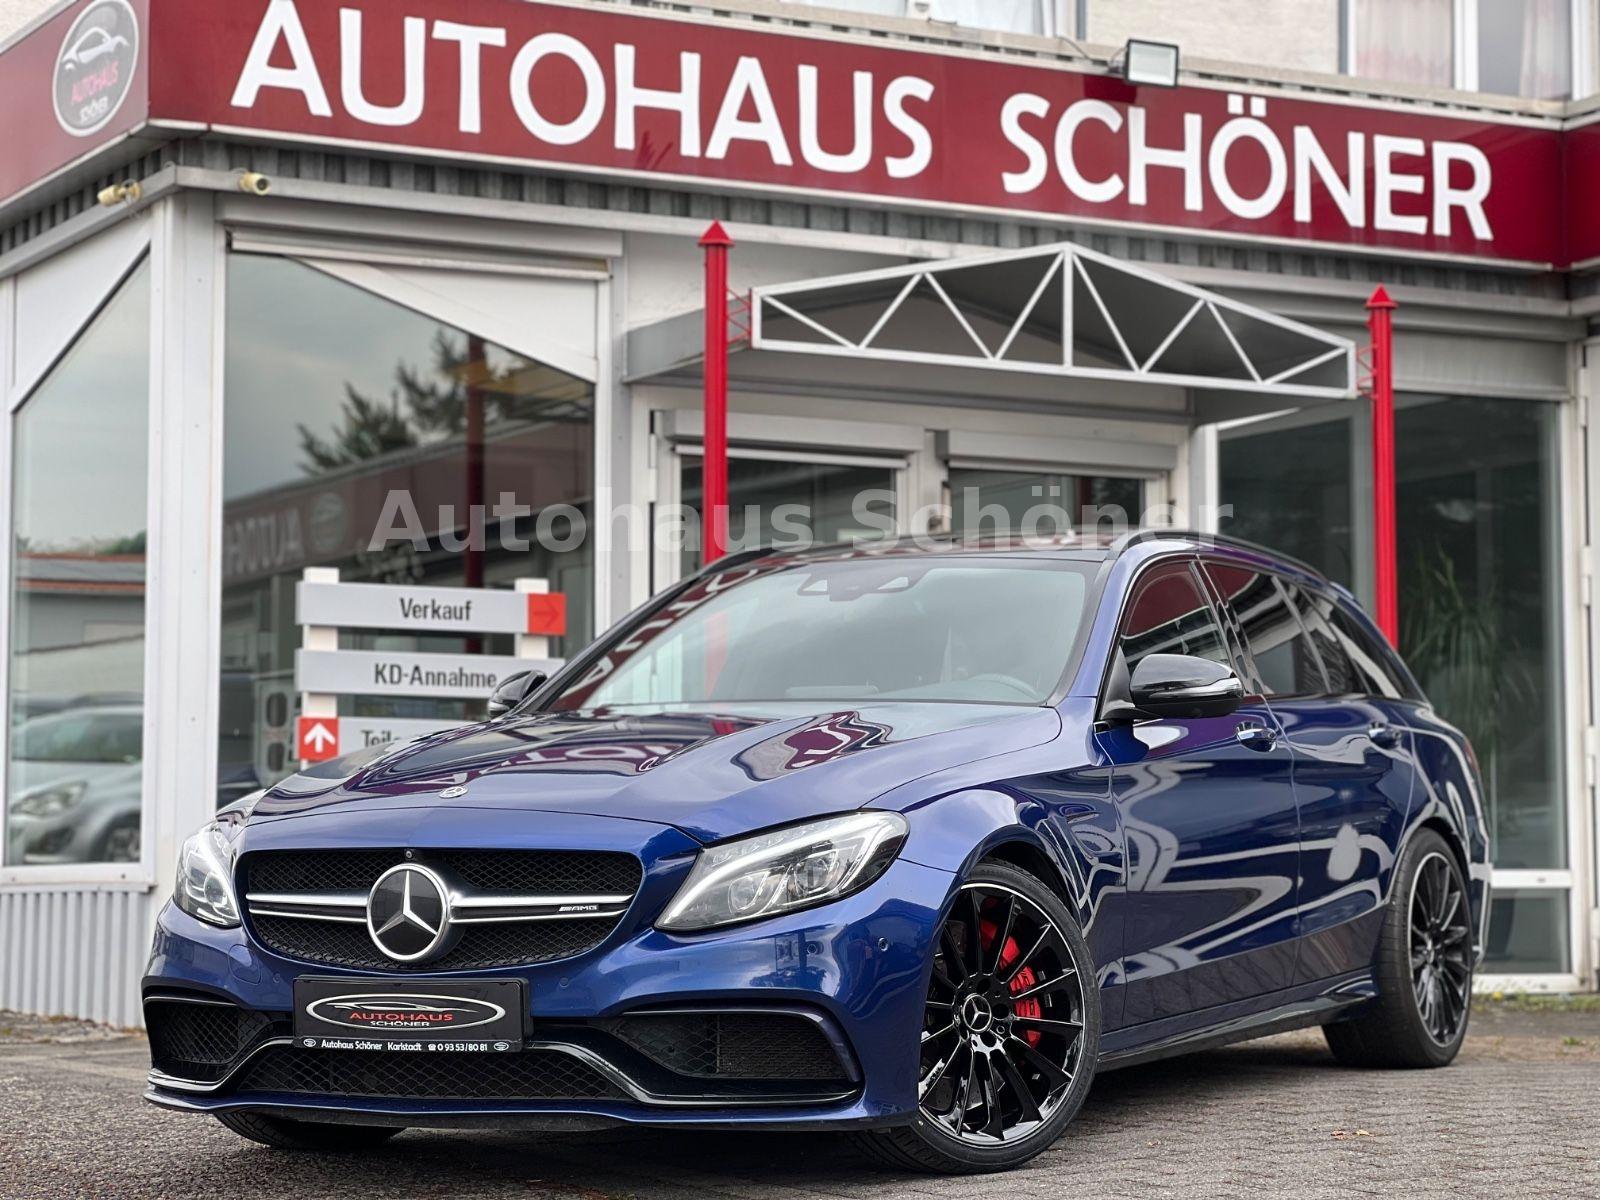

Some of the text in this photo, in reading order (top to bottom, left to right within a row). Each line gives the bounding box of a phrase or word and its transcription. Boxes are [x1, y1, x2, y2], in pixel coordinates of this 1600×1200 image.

[231, 0, 1493, 240] AUTOHAUS SCHÖNER
[399, 597, 472, 621] Verkauf
[374, 663, 497, 689] KD-Annahme
[361, 729, 401, 747] Teil
[349, 1012, 454, 1021] AUTOHAUS
[370, 1019, 430, 1027] SCHÖNER
[321, 1039, 354, 1049] Autohaus
[355, 1041, 382, 1050] Schöner
[387, 1041, 422, 1051] Karlstadt
